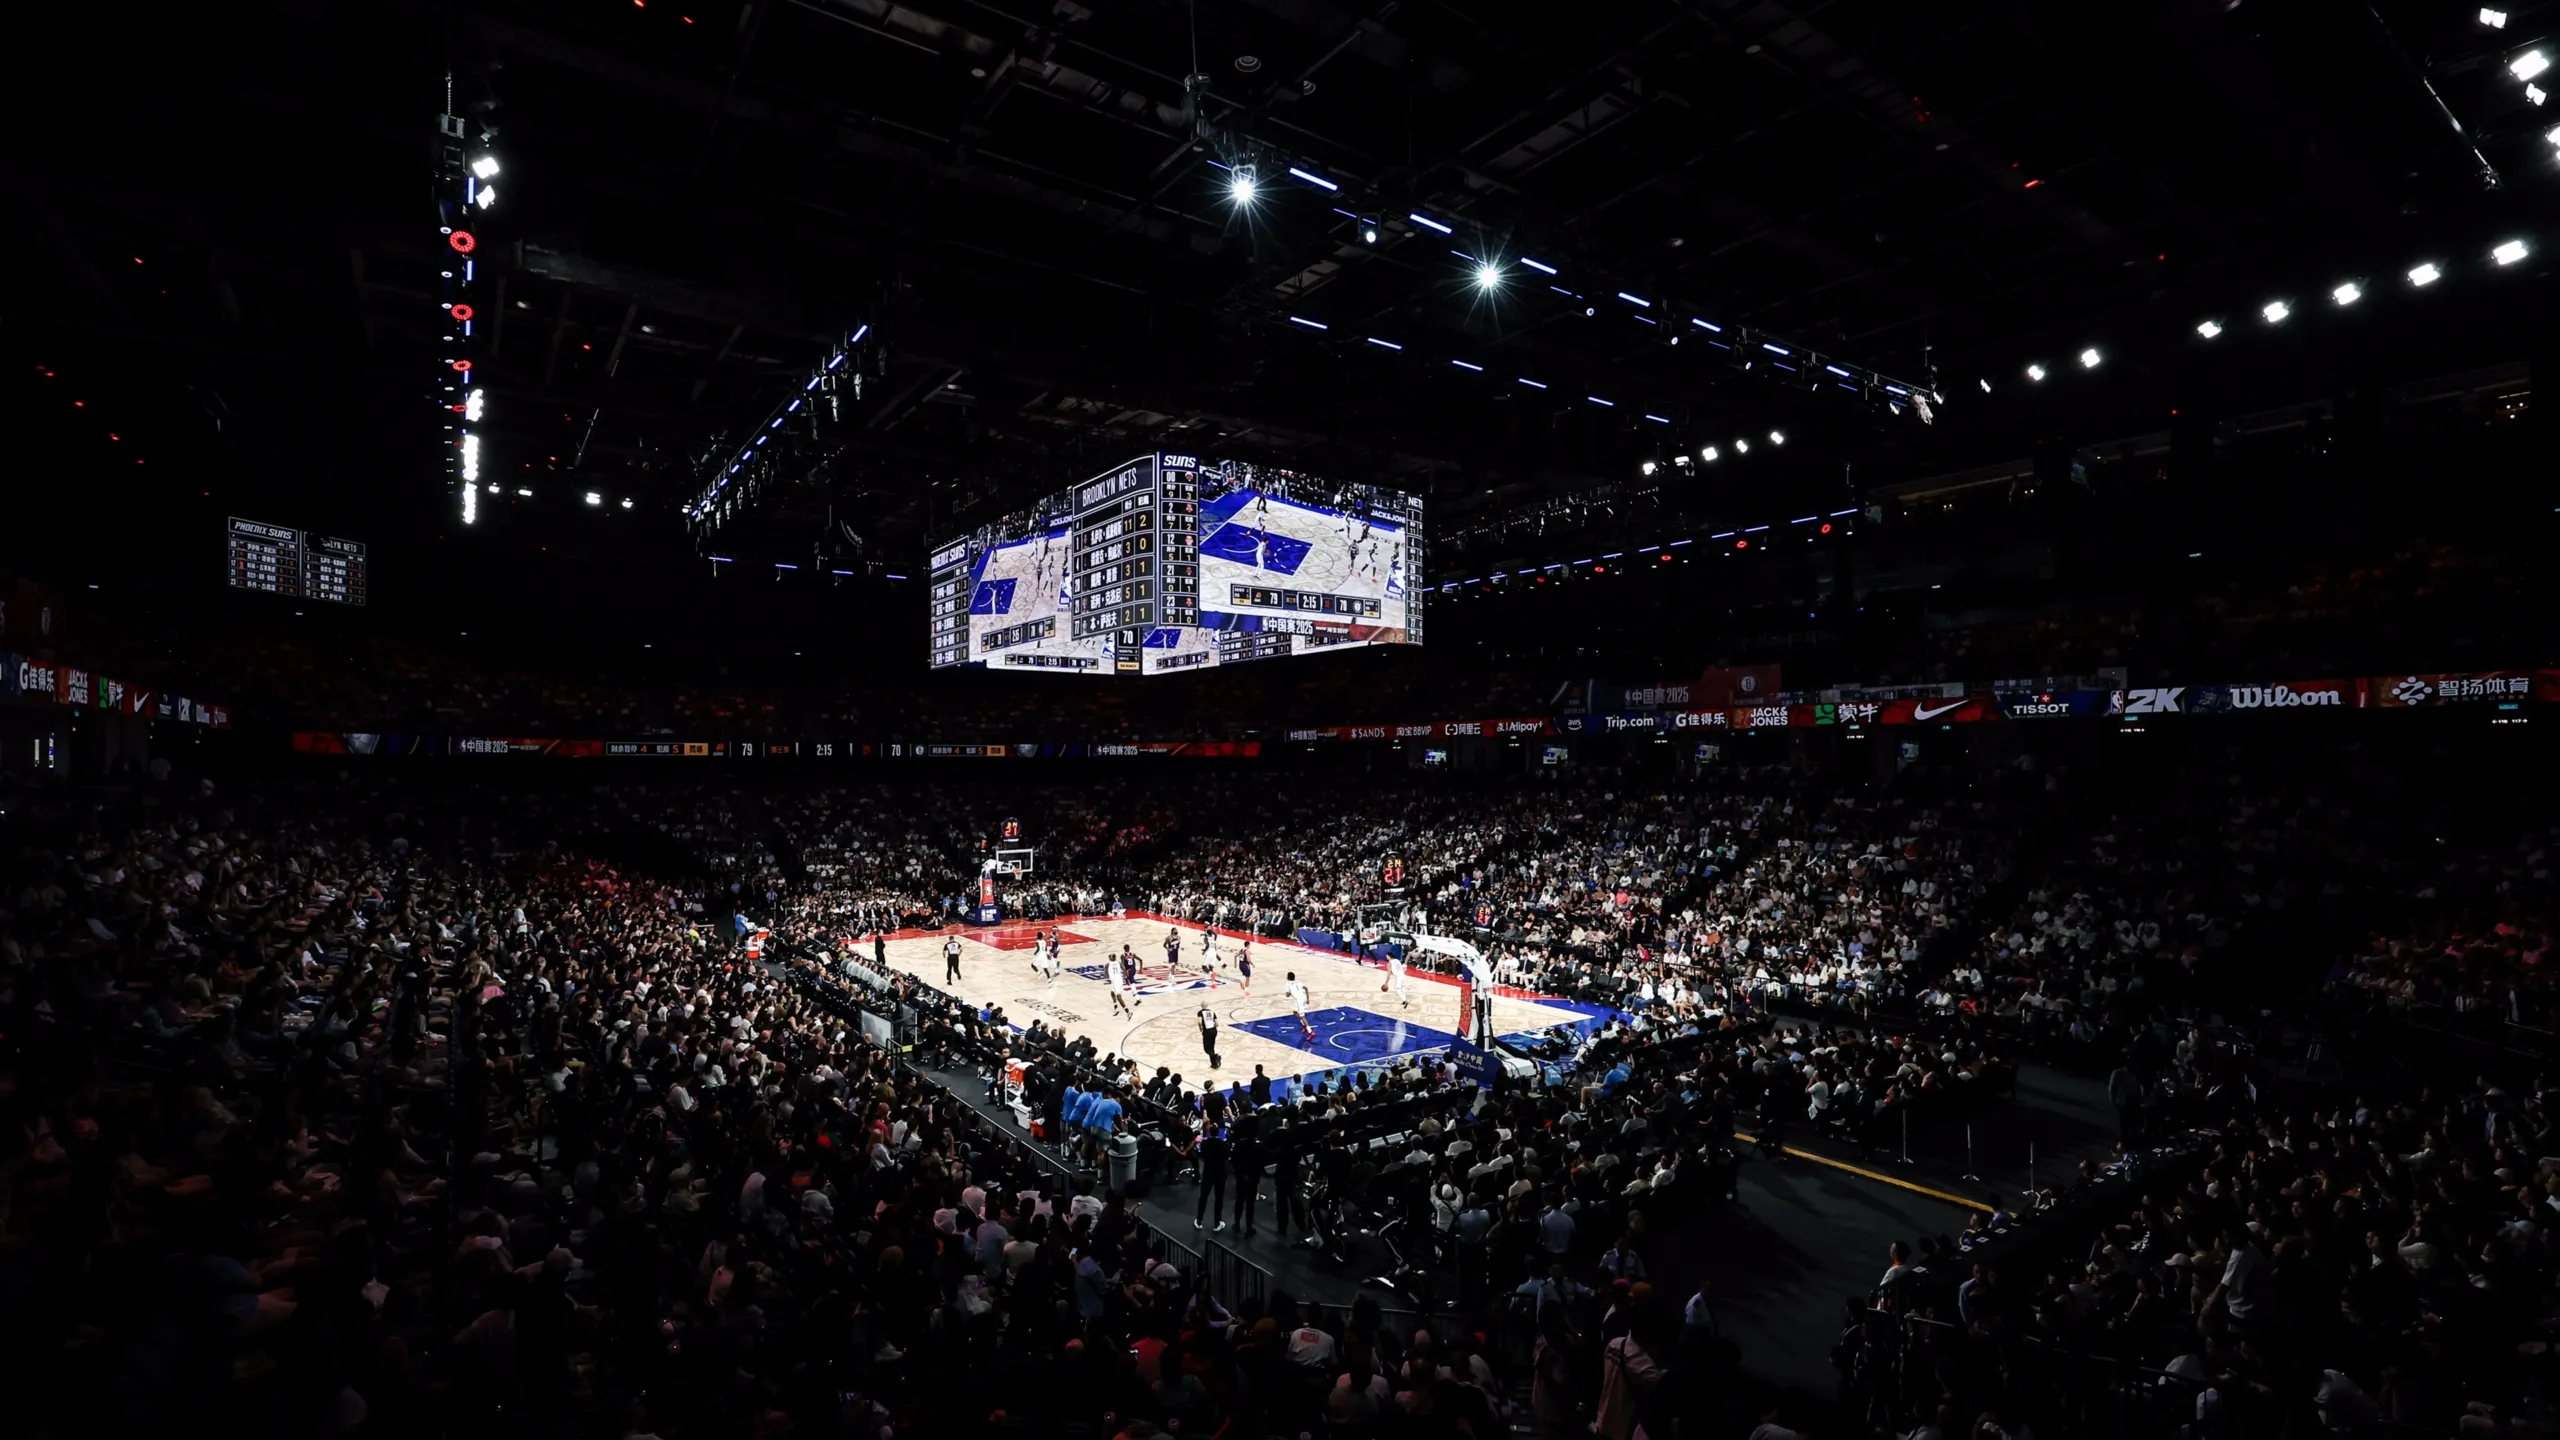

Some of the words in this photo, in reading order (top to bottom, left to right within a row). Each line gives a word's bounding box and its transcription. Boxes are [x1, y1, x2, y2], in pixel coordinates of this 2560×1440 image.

[1163, 455, 1197, 468] SUNS
[1166, 471, 1176, 482] 00
[1082, 477, 1116, 507] BROOKLYN
[1118, 467, 1138, 493] NETS
[1168, 491, 1174, 499] 9
[1186, 492, 1192, 500] 3
[1168, 502, 1174, 513] 2
[234, 521, 267, 534] PHOENIX
[268, 528, 293, 541] SUNS
[1124, 518, 1132, 534] 11
[1139, 514, 1147, 528] 2
[1168, 522, 1174, 530] 7
[1125, 541, 1131, 555] 3
[1139, 538, 1148, 551] 0
[1167, 533, 1176, 545] 12
[1168, 553, 1174, 561] 5
[1125, 564, 1131, 577] 3
[1140, 561, 1145, 574] 1
[1167, 565, 1175, 577] 21
[1125, 587, 1131, 600] 5
[1140, 584, 1145, 597] 1
[1168, 584, 1174, 592] 0
[1166, 596, 1176, 607] 23
[1269, 592, 1278, 605] 79
[1302, 595, 1317, 609] 2:15
[1339, 600, 1347, 611] 70
[1125, 610, 1131, 622] 2
[1140, 607, 1145, 620] 1
[1168, 615, 1174, 623] 0
[1186, 616, 1192, 624] 0
[1268, 617, 1314, 636] 中国赛2025
[1122, 630, 1134, 645] 70
[29, 667, 55, 693] 佳得乐
[2438, 677, 2530, 697] 智扬体育
[68, 686, 88, 705] JONES
[108, 679, 124, 711] 蒙牛
[2124, 686, 2187, 714] 2K
[2229, 685, 2341, 709] Wilson
[1750, 706, 1788, 718] JACK&
[1838, 703, 1878, 724] 蒙牛
[2013, 703, 2070, 715] TISSOT
[1568, 718, 1582, 727] aws
[1605, 716, 1654, 731] Trip.com
[1687, 712, 1726, 726] 佳得乐
[1750, 716, 1788, 727] JONES
[1358, 727, 1386, 739] SANDS
[1396, 725, 1432, 738] 淘宝88VIP
[1458, 722, 1481, 735] 阿里云
[1508, 720, 1544, 733] Alipay+
[467, 739, 509, 754] 中国赛2025
[640, 744, 647, 753] 4
[672, 744, 680, 754] 5
[742, 743, 753, 756] 79
[816, 743, 832, 756] 2:15
[891, 744, 902, 757] 70
[978, 746, 984, 755] 5
[1102, 745, 1139, 756] 中国赛2025
[1384, 868, 1401, 884] 21
